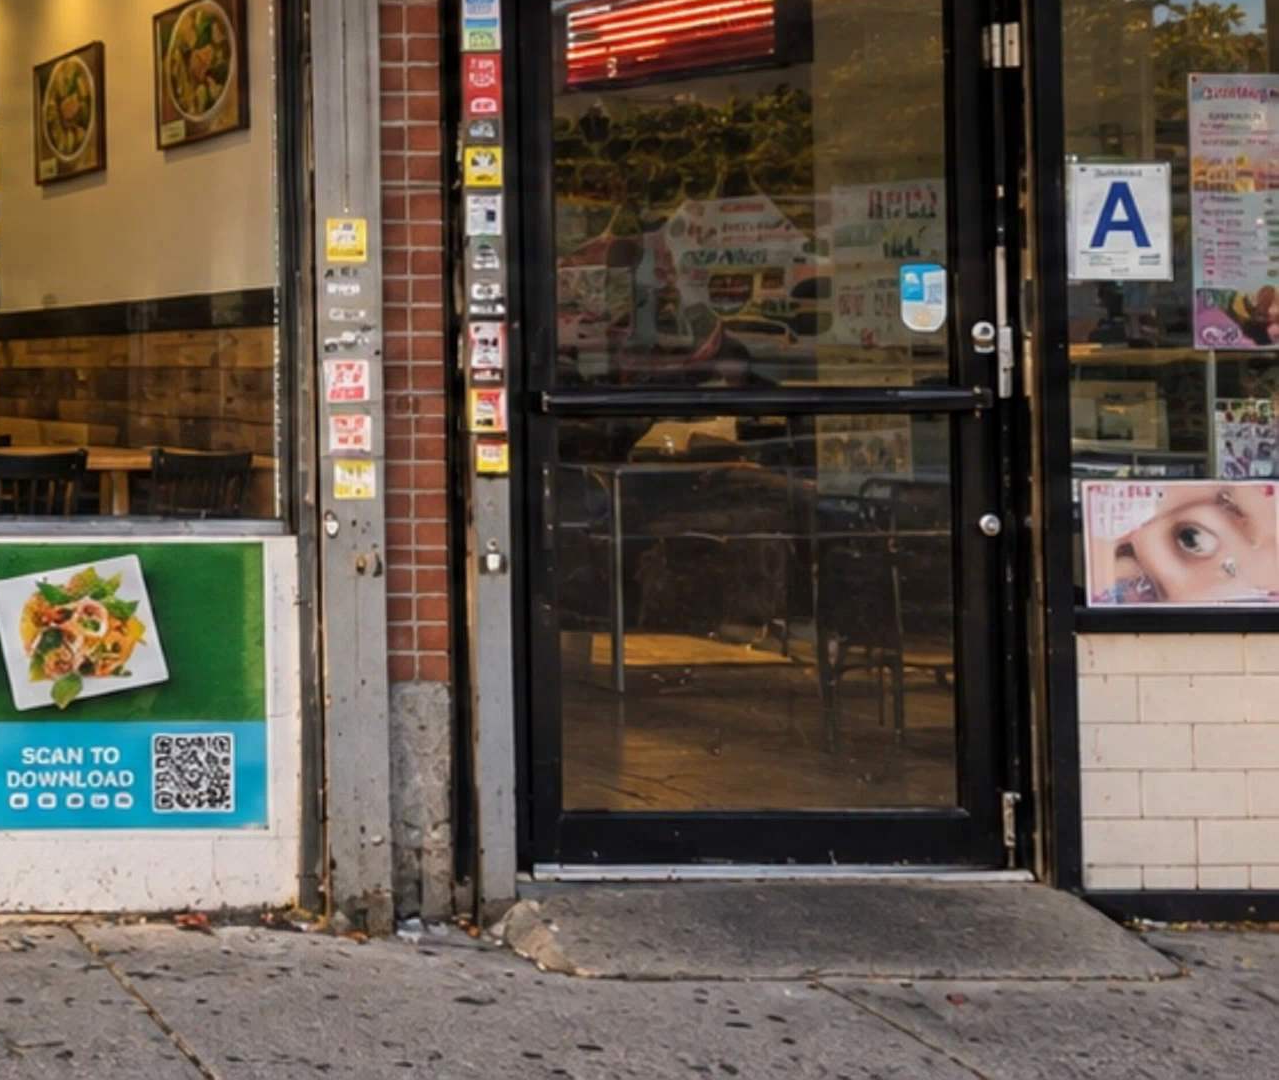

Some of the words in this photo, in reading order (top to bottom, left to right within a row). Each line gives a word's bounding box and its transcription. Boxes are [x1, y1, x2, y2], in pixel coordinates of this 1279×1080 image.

[1089, 181, 1151, 248] A
[21, 746, 84, 765] SCAN
[89, 746, 121, 765] TO
[6, 770, 135, 788] DOWNLOAD
